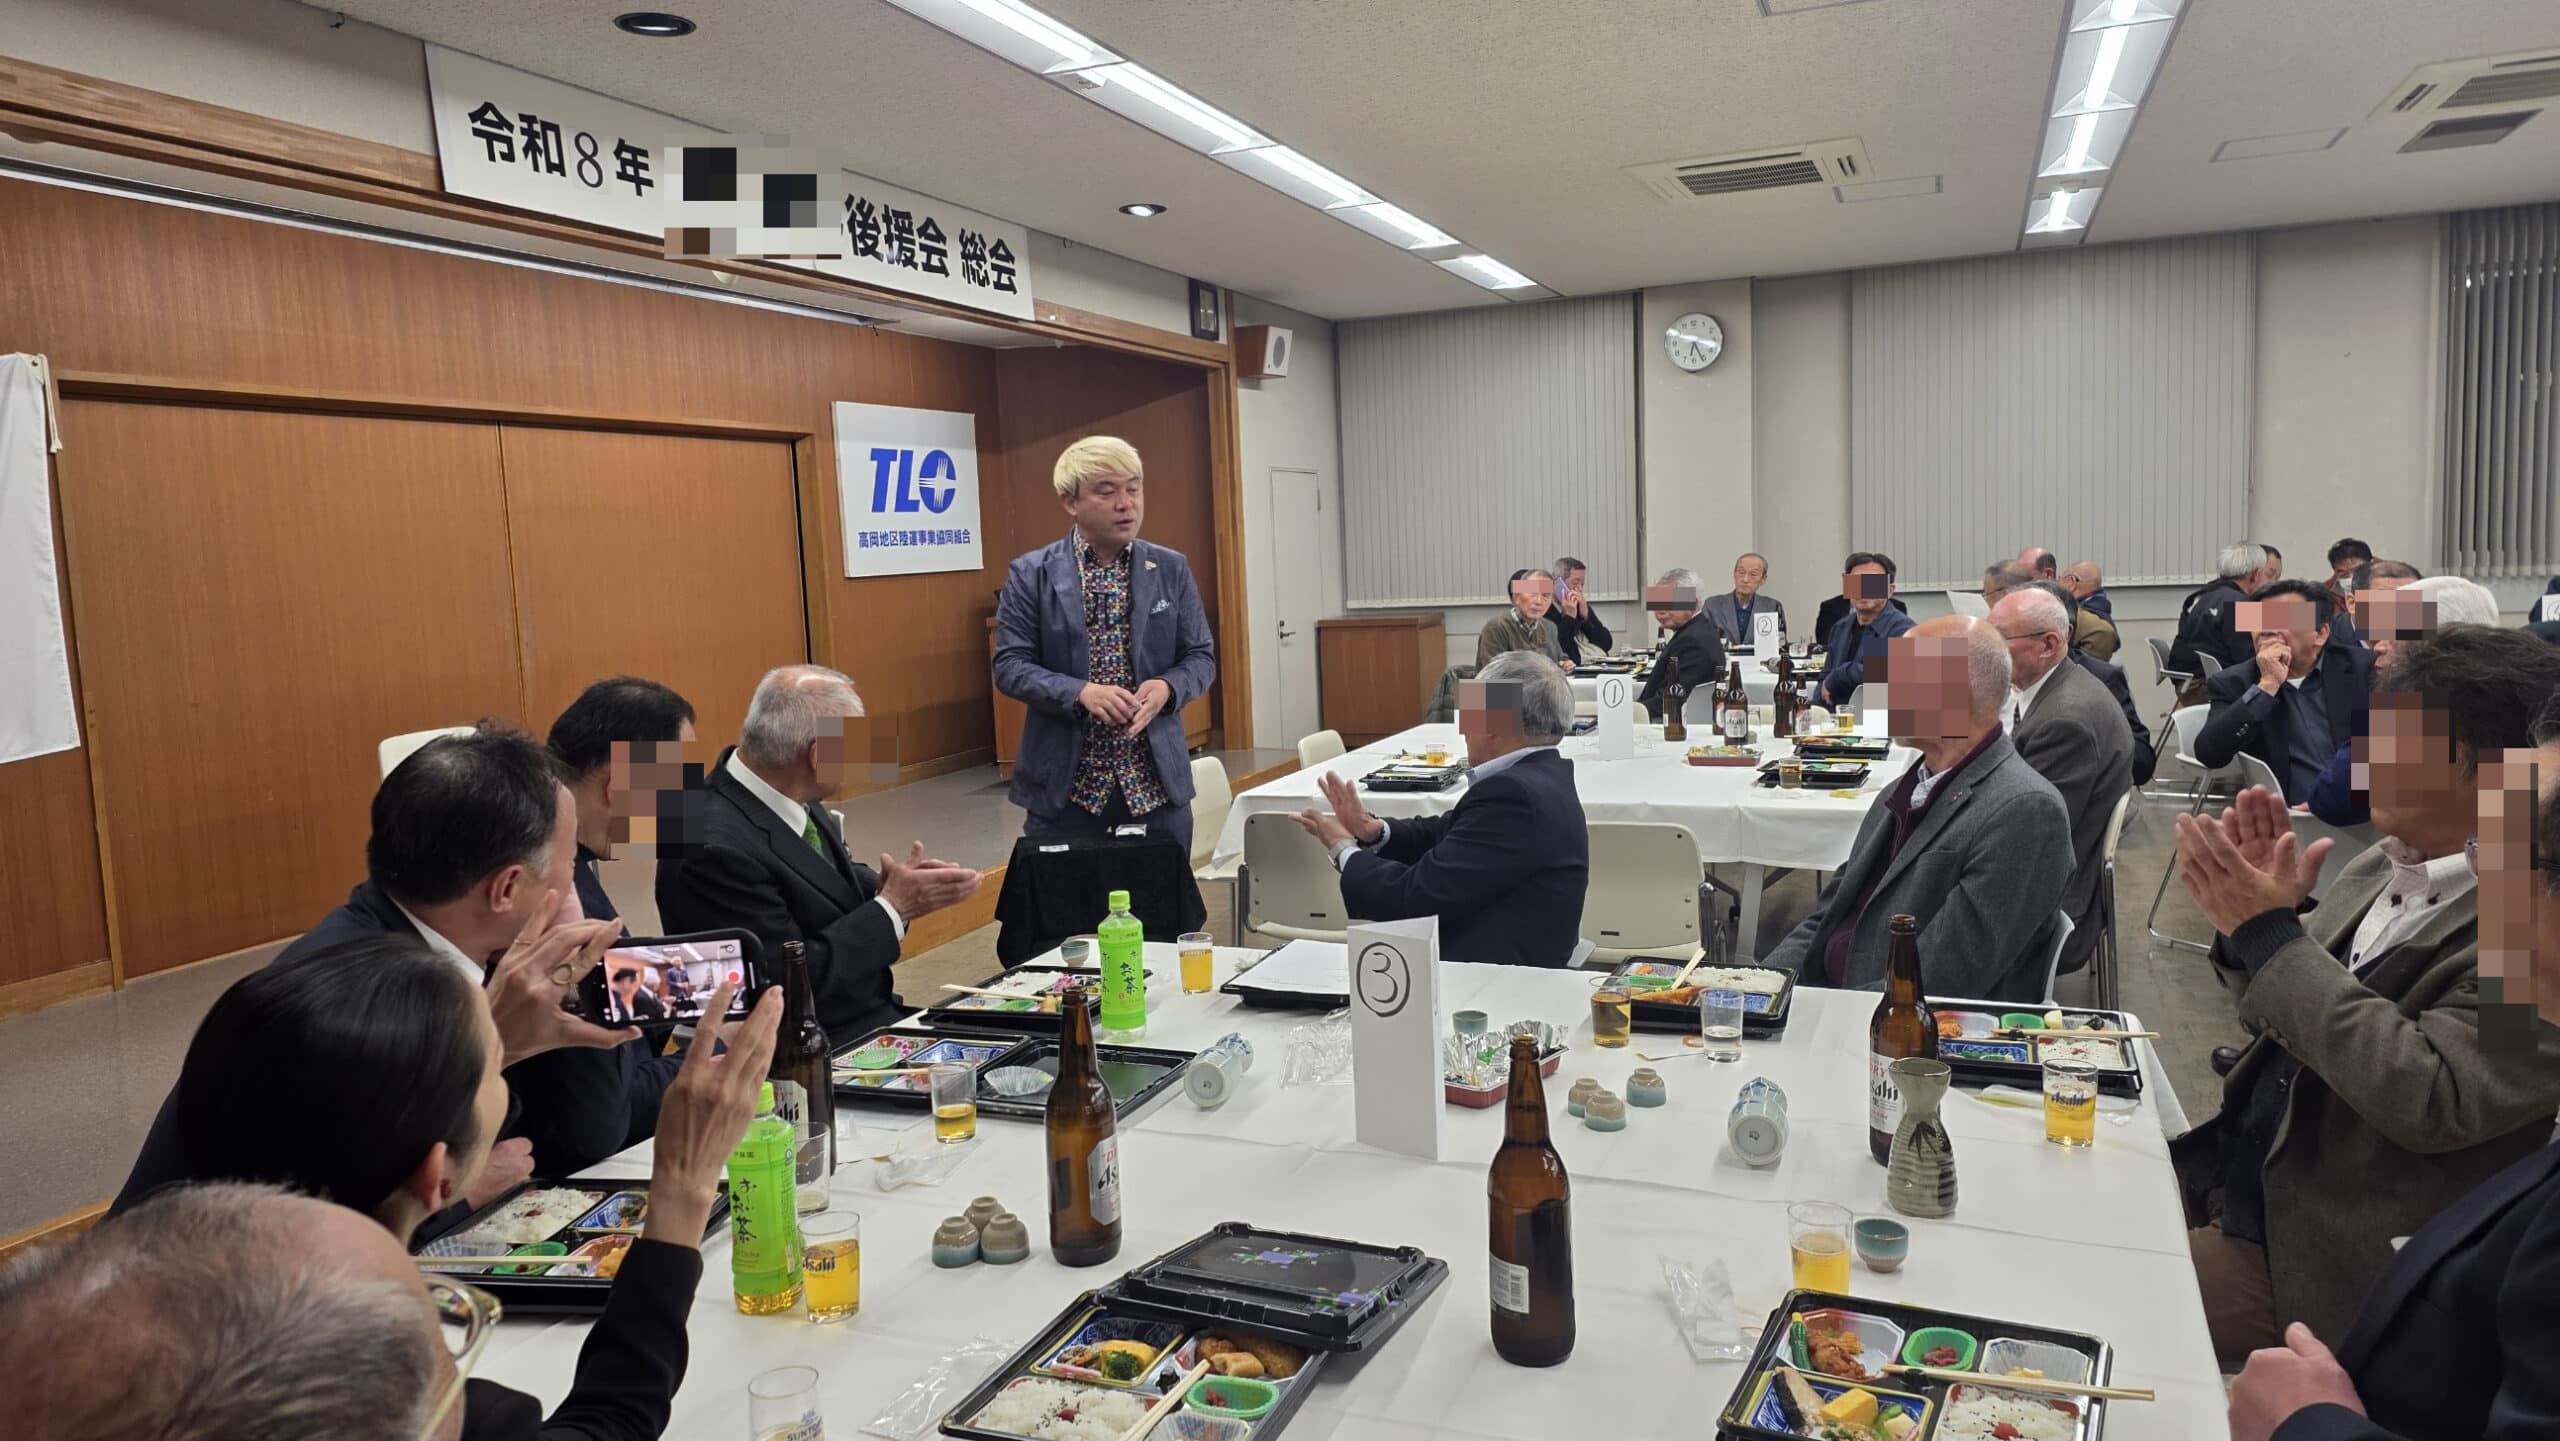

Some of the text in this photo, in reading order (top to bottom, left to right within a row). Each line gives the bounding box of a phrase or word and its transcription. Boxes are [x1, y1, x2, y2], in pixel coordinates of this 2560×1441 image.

[467, 100, 655, 197] 令和8年
[958, 227, 1018, 295] 総会
[858, 529, 971, 549] 高岡地区陸運事業協同組合
[2051, 1091, 2085, 1107] Asahi
